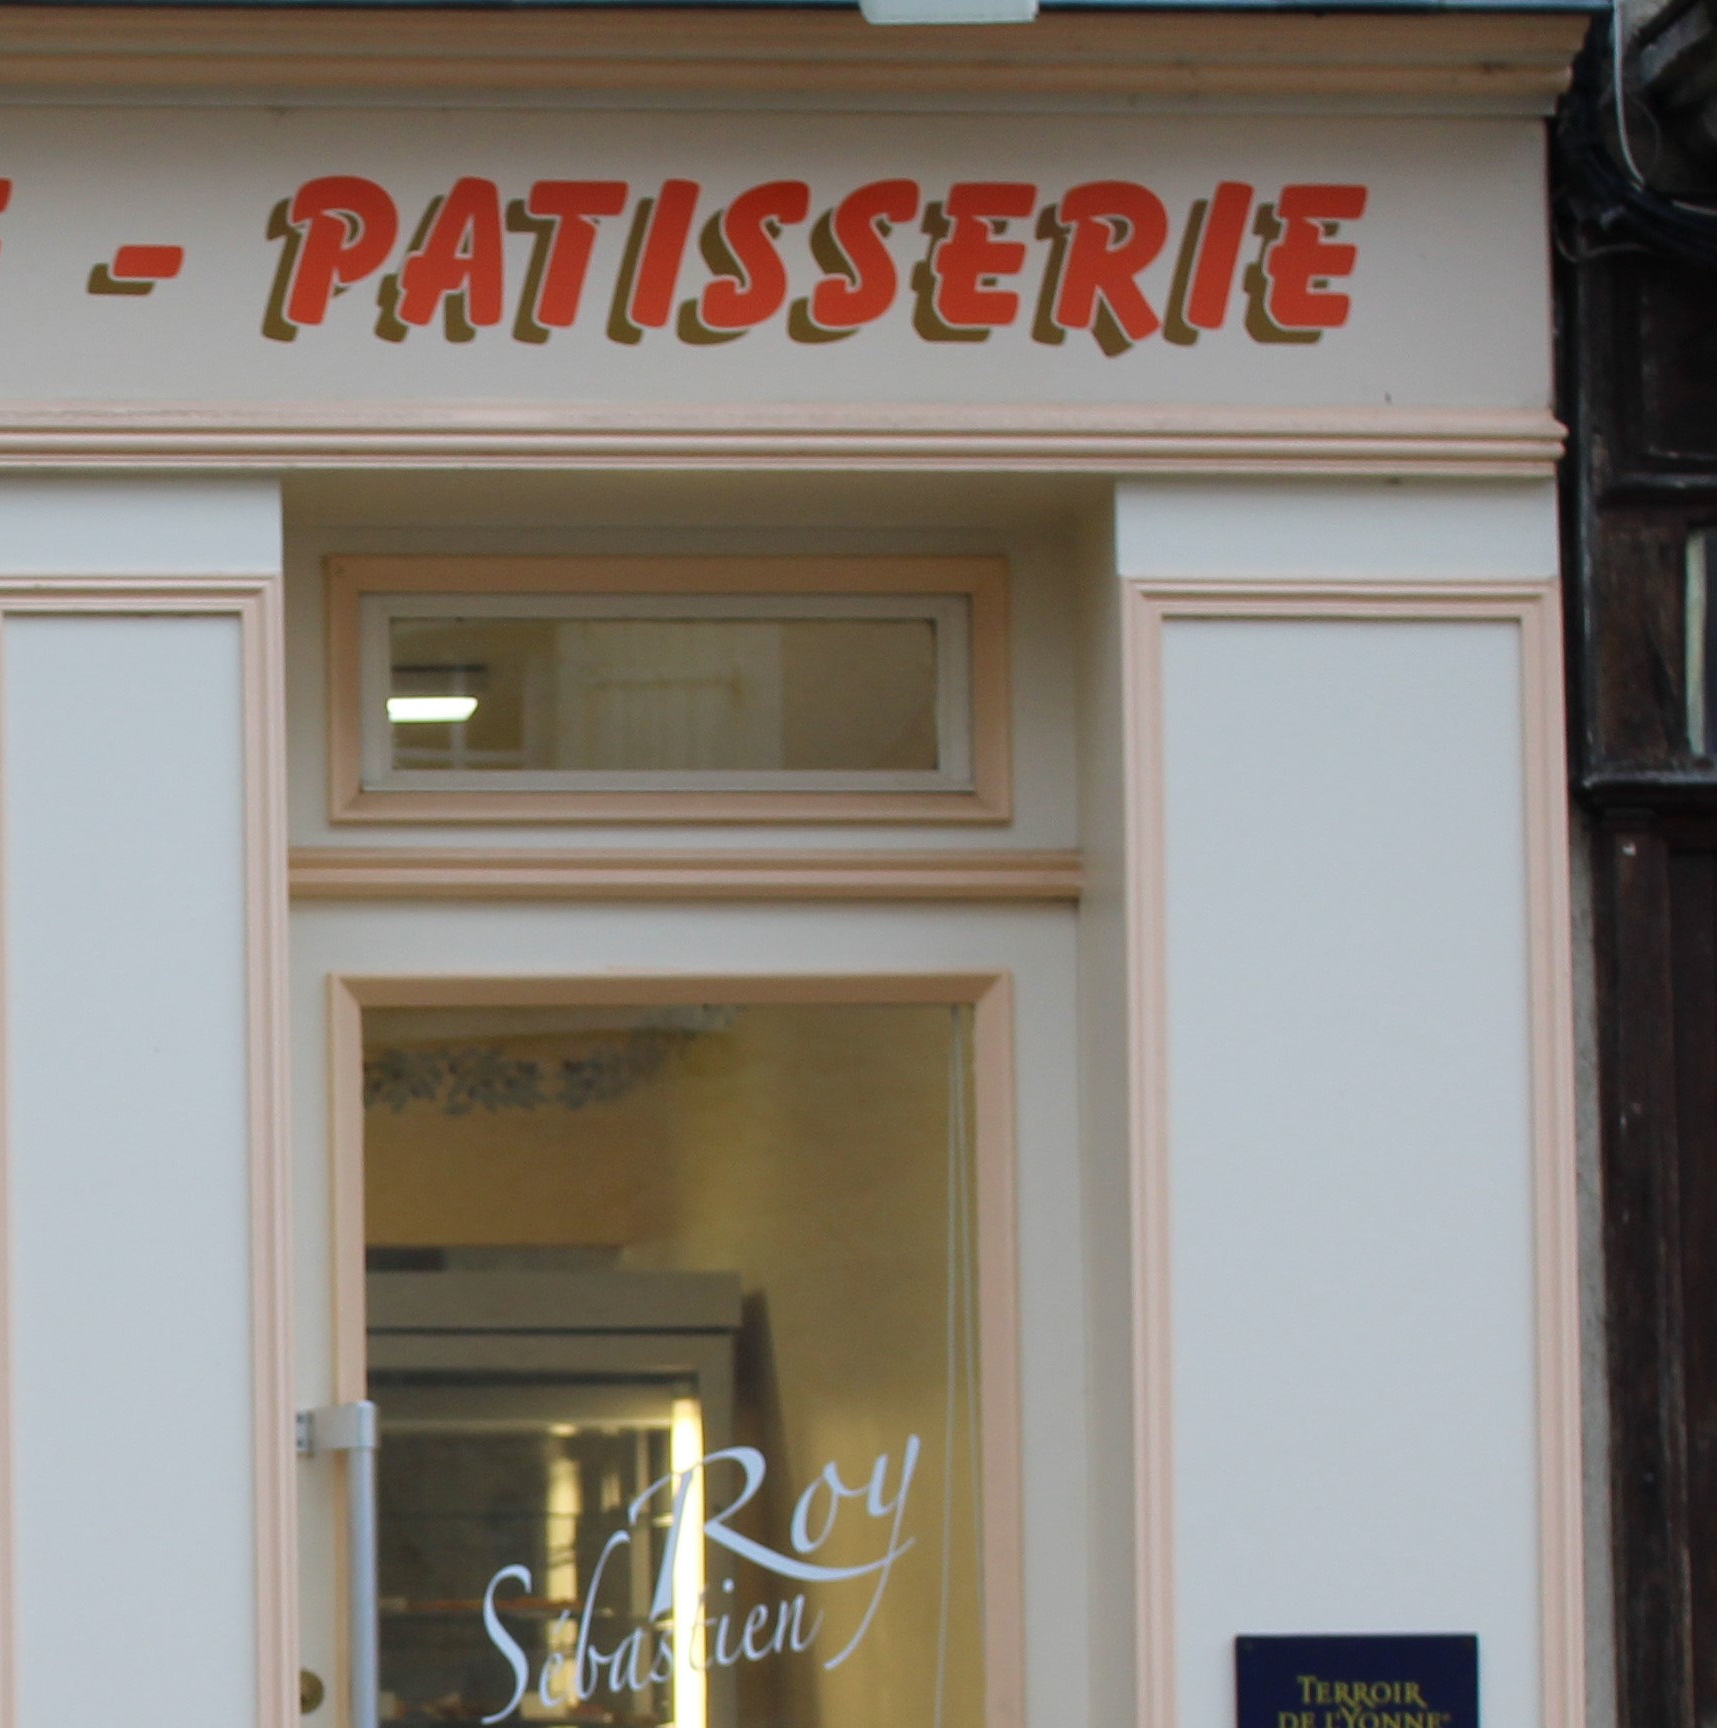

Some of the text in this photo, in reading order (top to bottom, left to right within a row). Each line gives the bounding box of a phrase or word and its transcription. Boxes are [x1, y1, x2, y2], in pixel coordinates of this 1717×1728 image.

[88, 244, 185, 296] -
[263, 175, 1369, 357] PATISSERIE
[629, 1434, 921, 1670] Roy
[1297, 1675, 1427, 1708] TERROIR
